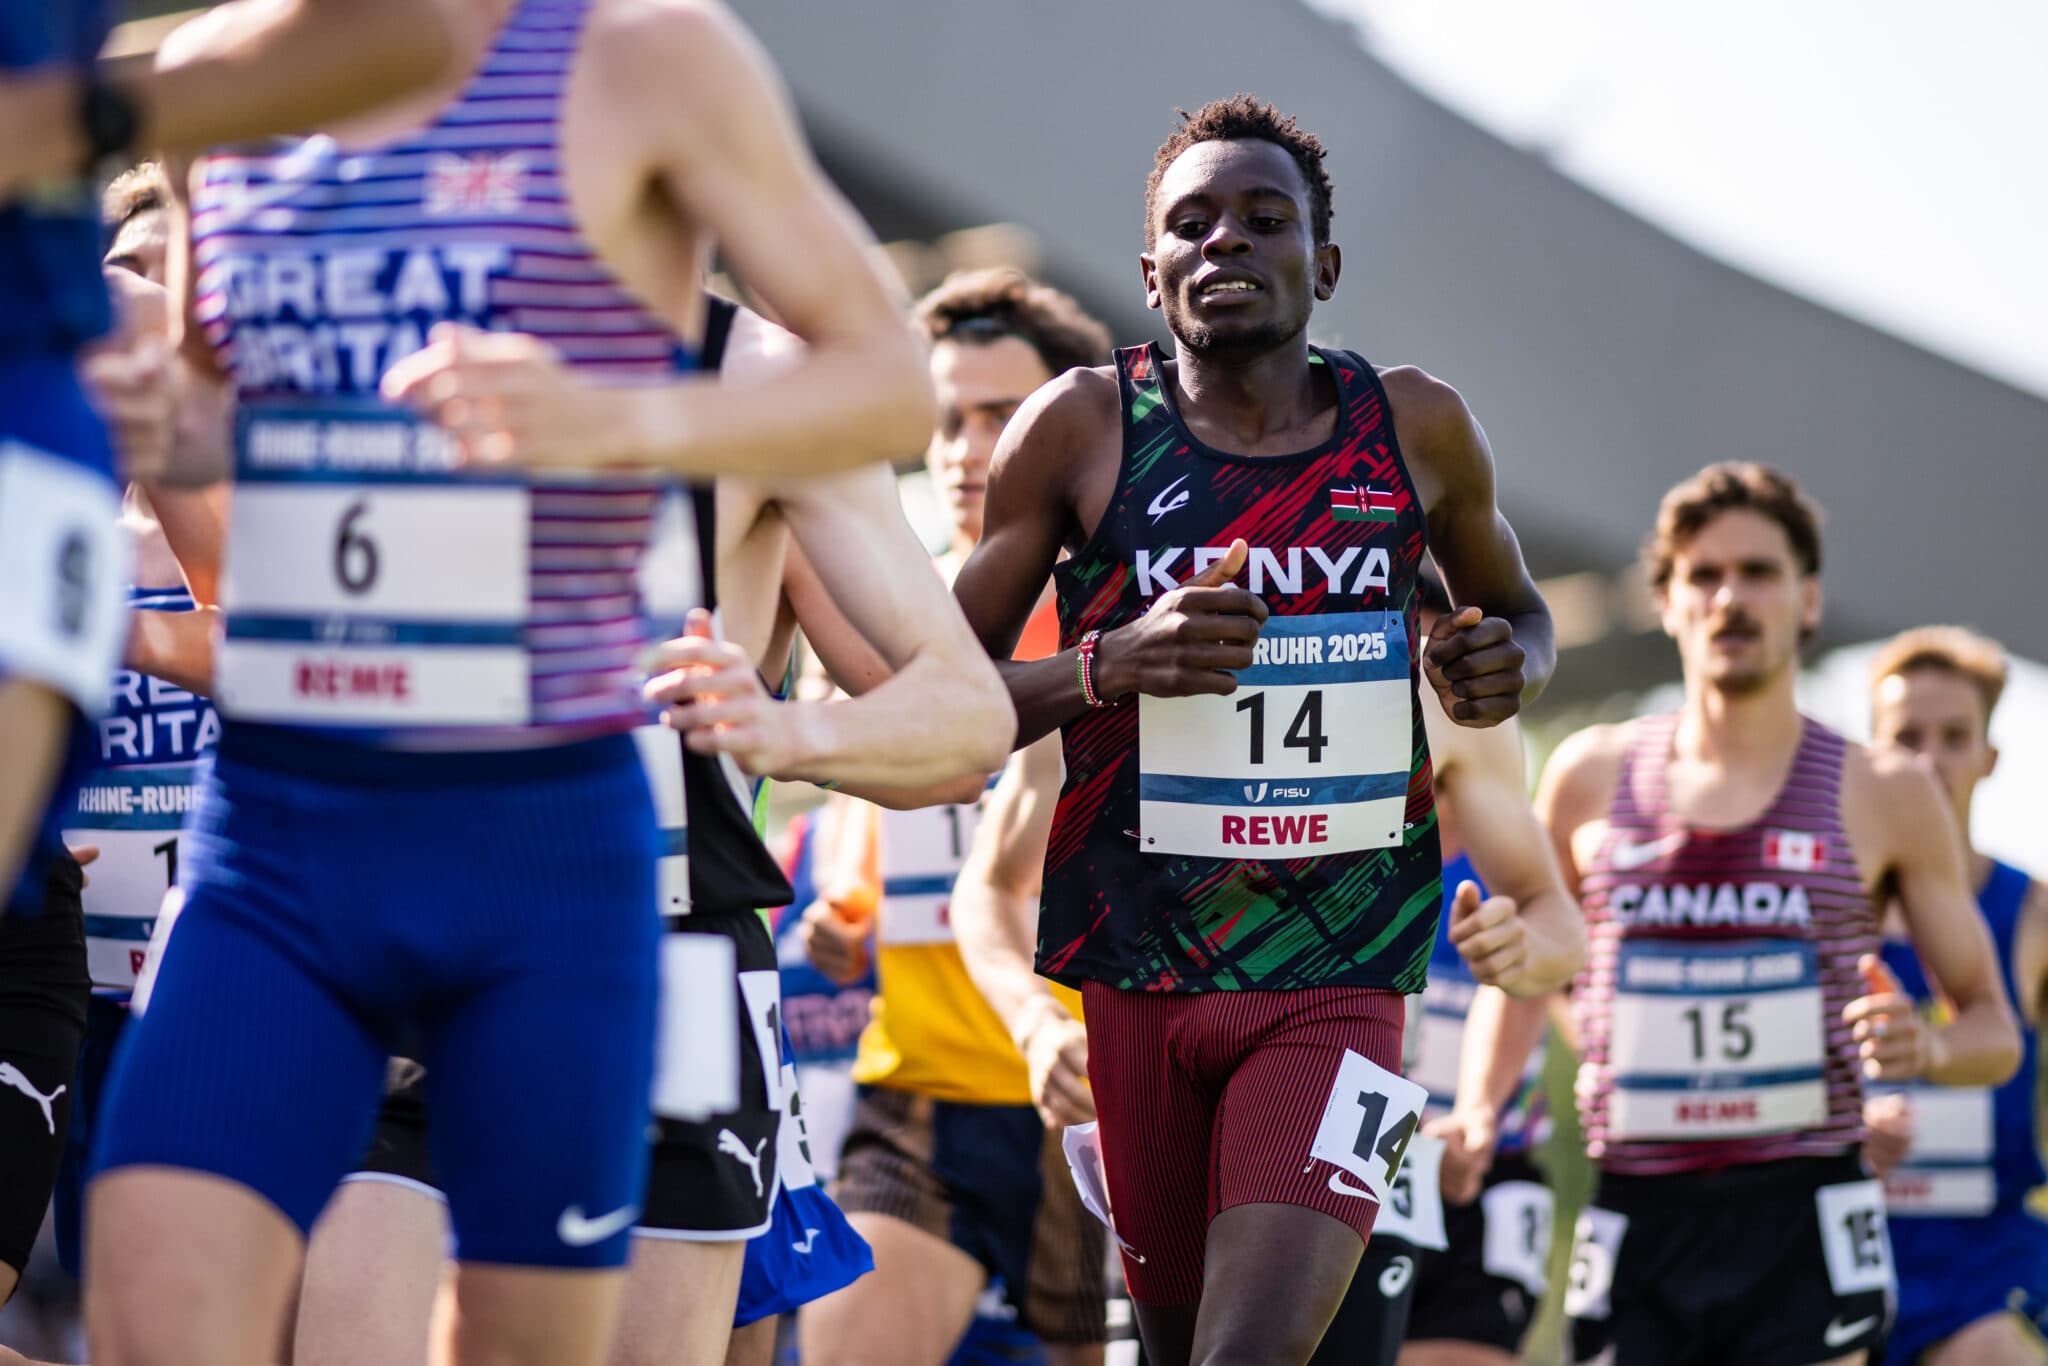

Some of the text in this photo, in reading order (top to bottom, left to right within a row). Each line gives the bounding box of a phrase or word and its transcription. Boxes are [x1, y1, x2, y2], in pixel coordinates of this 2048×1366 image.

[332, 500, 380, 597] 6
[1328, 632, 1388, 663] 2025
[101, 707, 221, 759] RITA
[1236, 690, 1328, 764] 14
[1273, 787, 1311, 798] FISU
[1222, 814, 1329, 846] REWE
[153, 837, 179, 887] 1
[1610, 882, 1812, 928] CANADA
[1680, 1002, 1755, 1061] 15
[1352, 1090, 1419, 1188] 14
